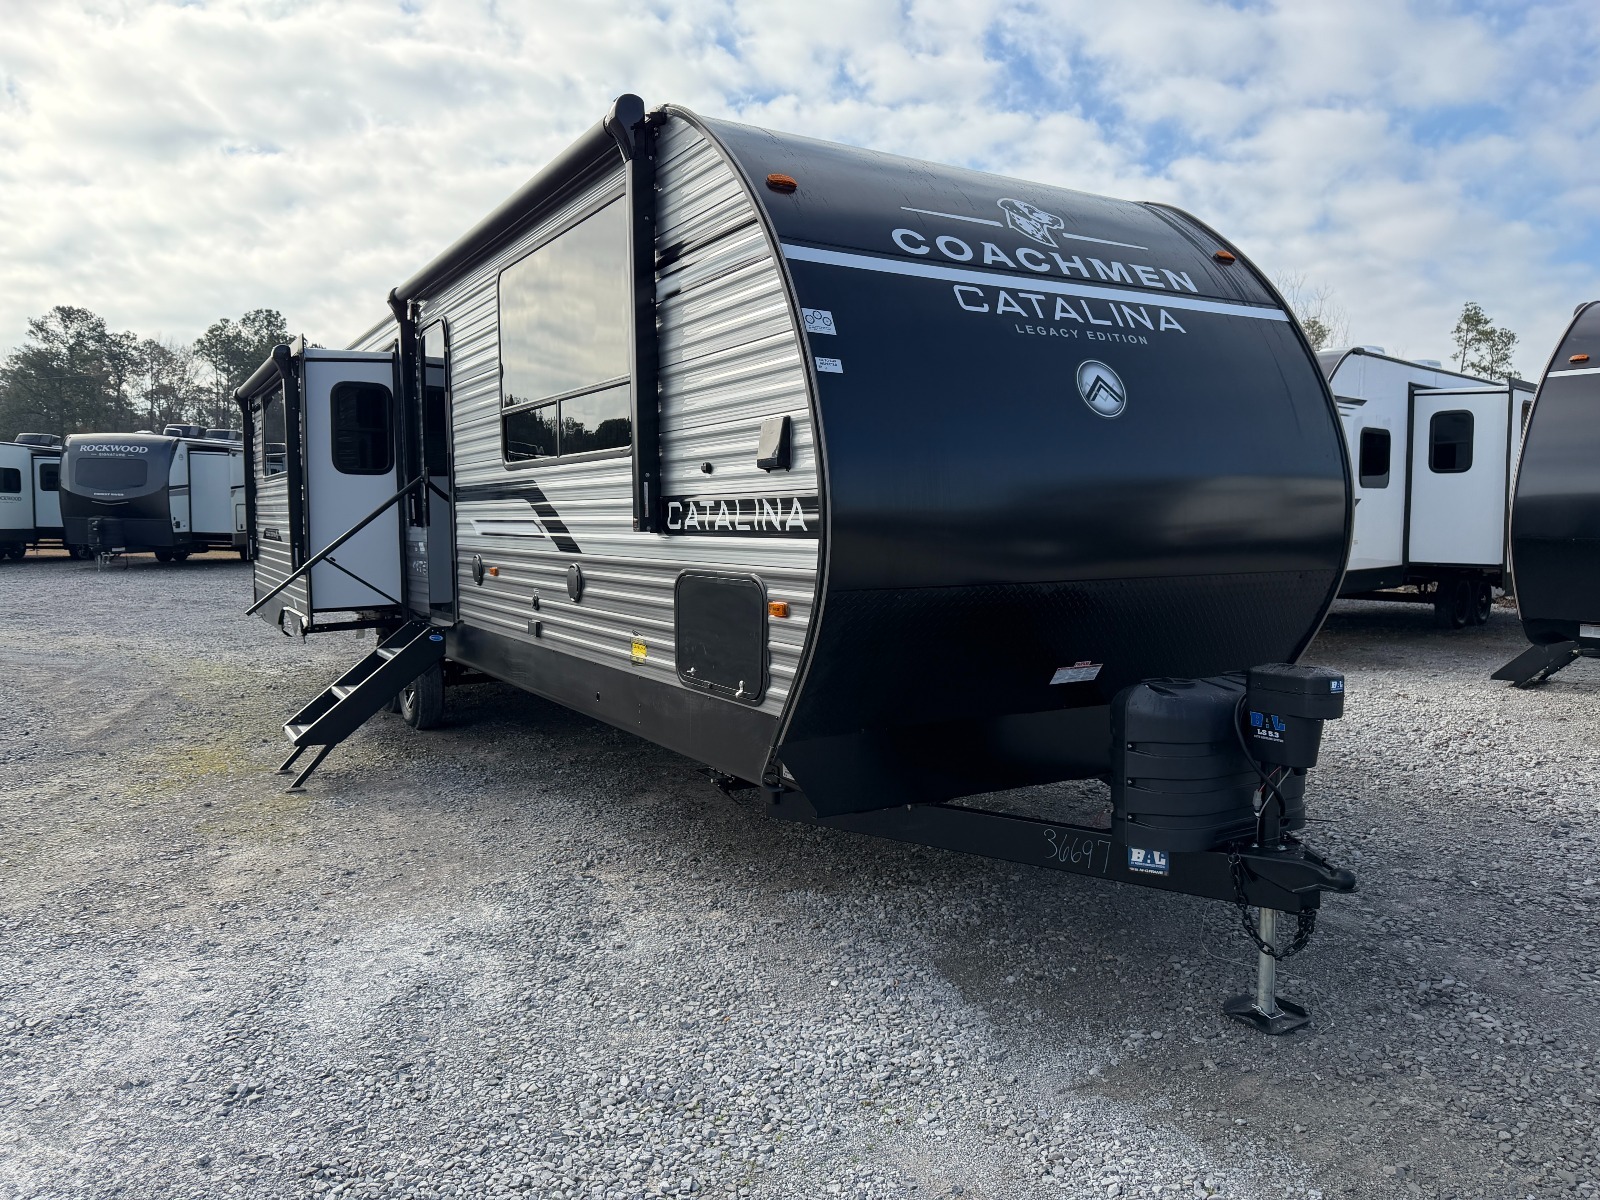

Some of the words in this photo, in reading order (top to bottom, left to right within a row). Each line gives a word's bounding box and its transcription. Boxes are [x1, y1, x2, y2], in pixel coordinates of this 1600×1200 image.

[891, 228, 1198, 293] COACHMEN
[953, 285, 1187, 334] CATALINA
[1015, 324, 1079, 339] LEGACY
[1086, 330, 1148, 346] EDITION
[80, 445, 148, 453] ROCKWOOD
[667, 498, 808, 531] CATALINA
[1043, 828, 1112, 874] 36697
